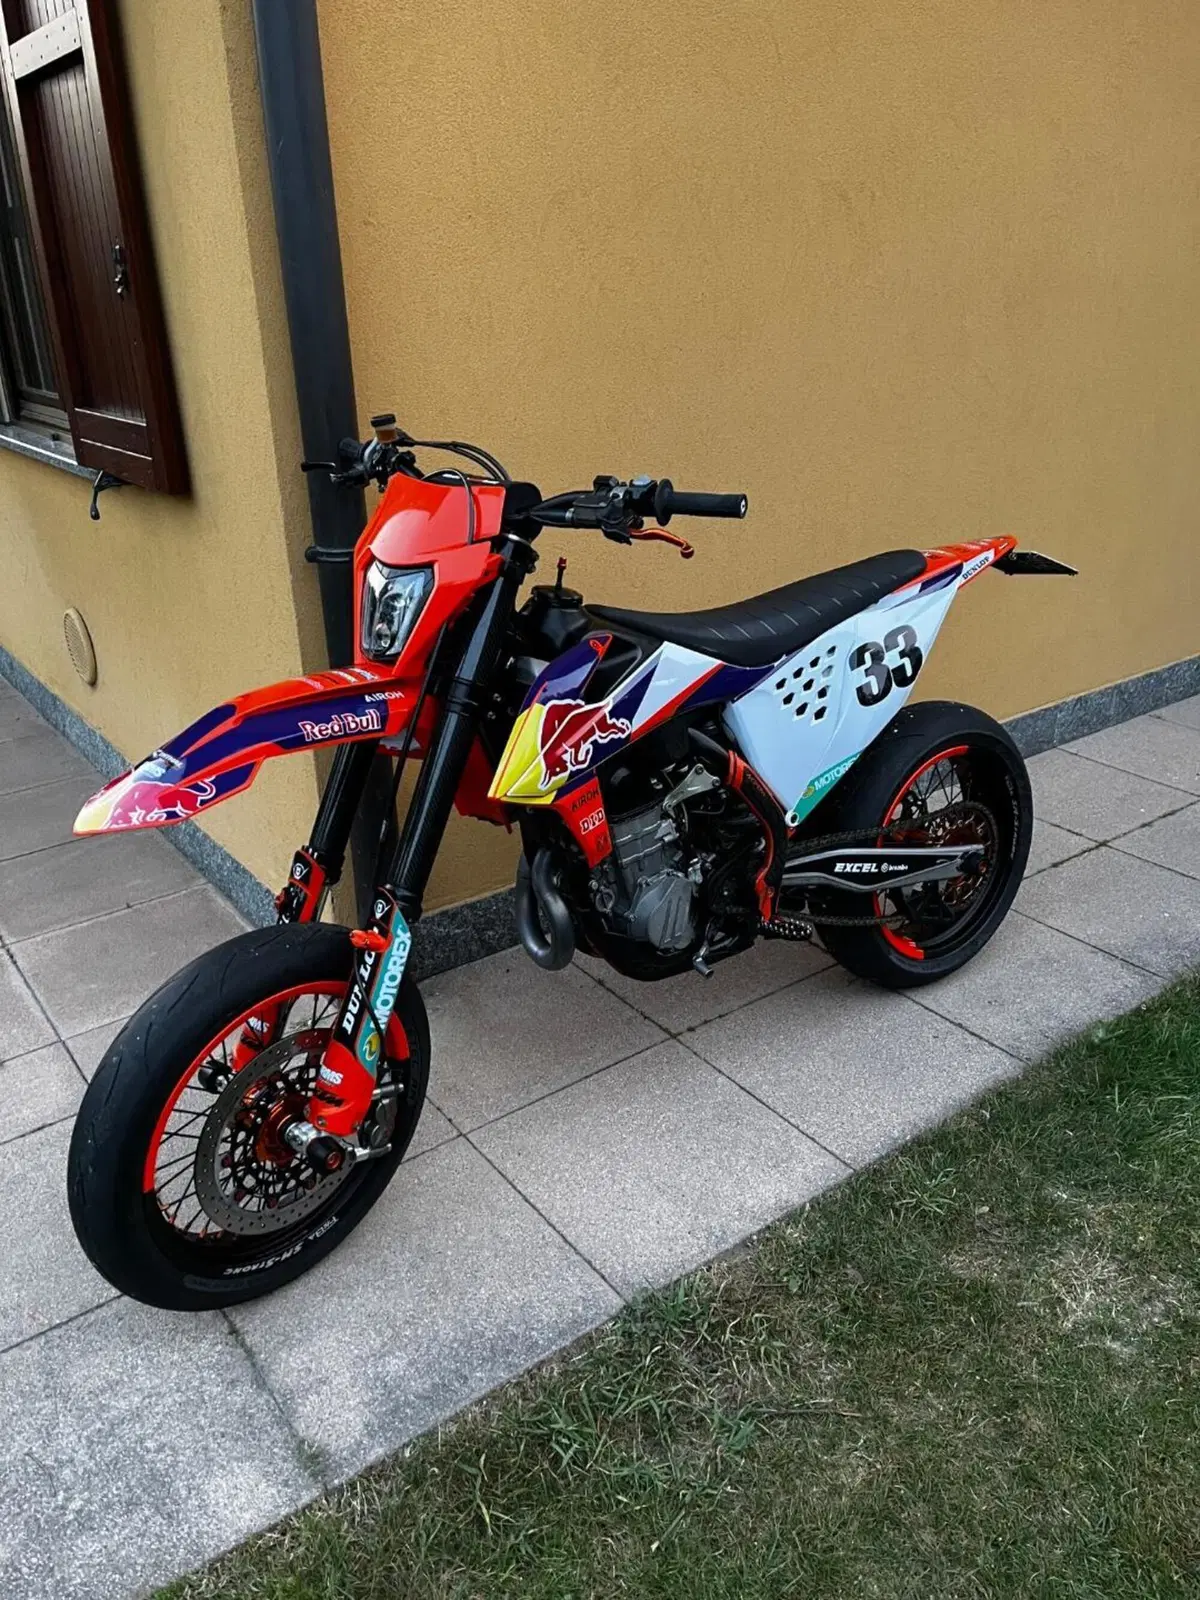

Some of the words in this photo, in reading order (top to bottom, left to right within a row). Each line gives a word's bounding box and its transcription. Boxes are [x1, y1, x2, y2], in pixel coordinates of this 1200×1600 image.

[962, 556, 990, 580] DUNLOP
[849, 624, 923, 707] 33
[364, 690, 404, 703] AIROH
[298, 715, 343, 742] Red
[343, 709, 381, 734] Bull
[814, 756, 859, 791] MOTOR
[834, 862, 879, 873] EXCEL
[341, 927, 379, 1035] DUNLO
[370, 926, 411, 1030] MOTOREX
